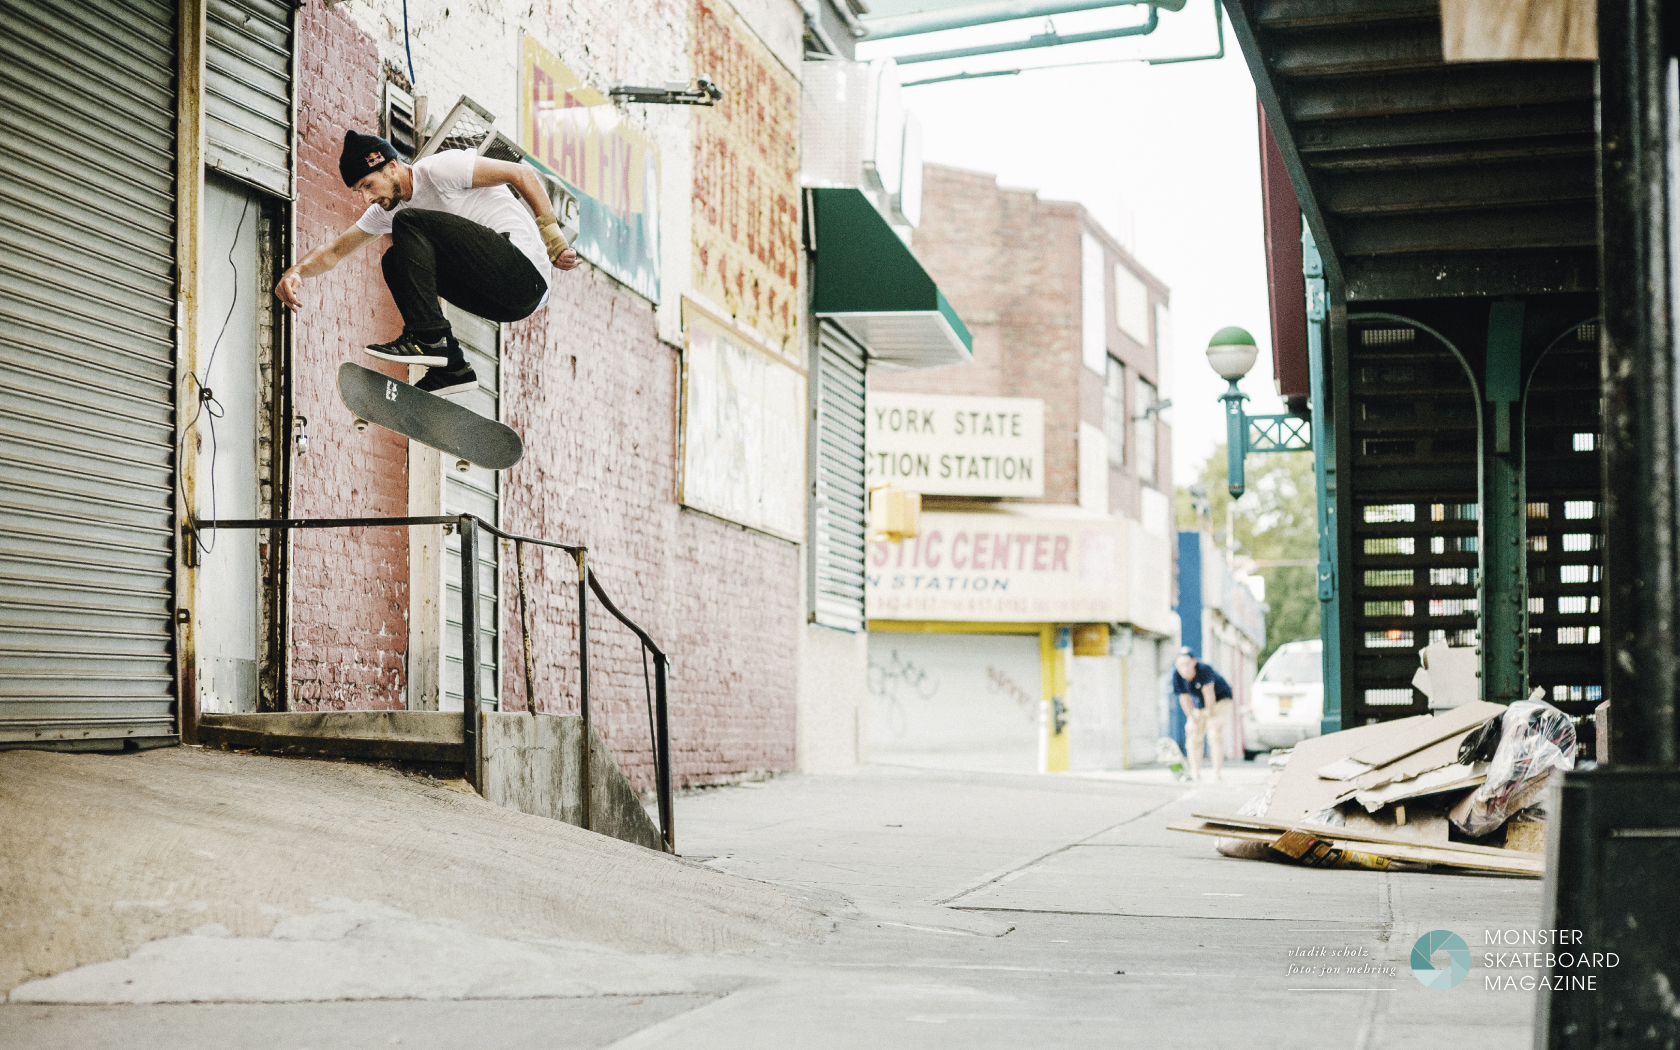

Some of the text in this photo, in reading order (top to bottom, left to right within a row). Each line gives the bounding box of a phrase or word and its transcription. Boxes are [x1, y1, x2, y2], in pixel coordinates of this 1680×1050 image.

[532, 64, 632, 227] FLAT FIX
[874, 406, 1022, 437] YORK STATE
[939, 454, 1032, 480] STATION
[951, 532, 1070, 571] CENTER
[891, 576, 1009, 591] STATION
